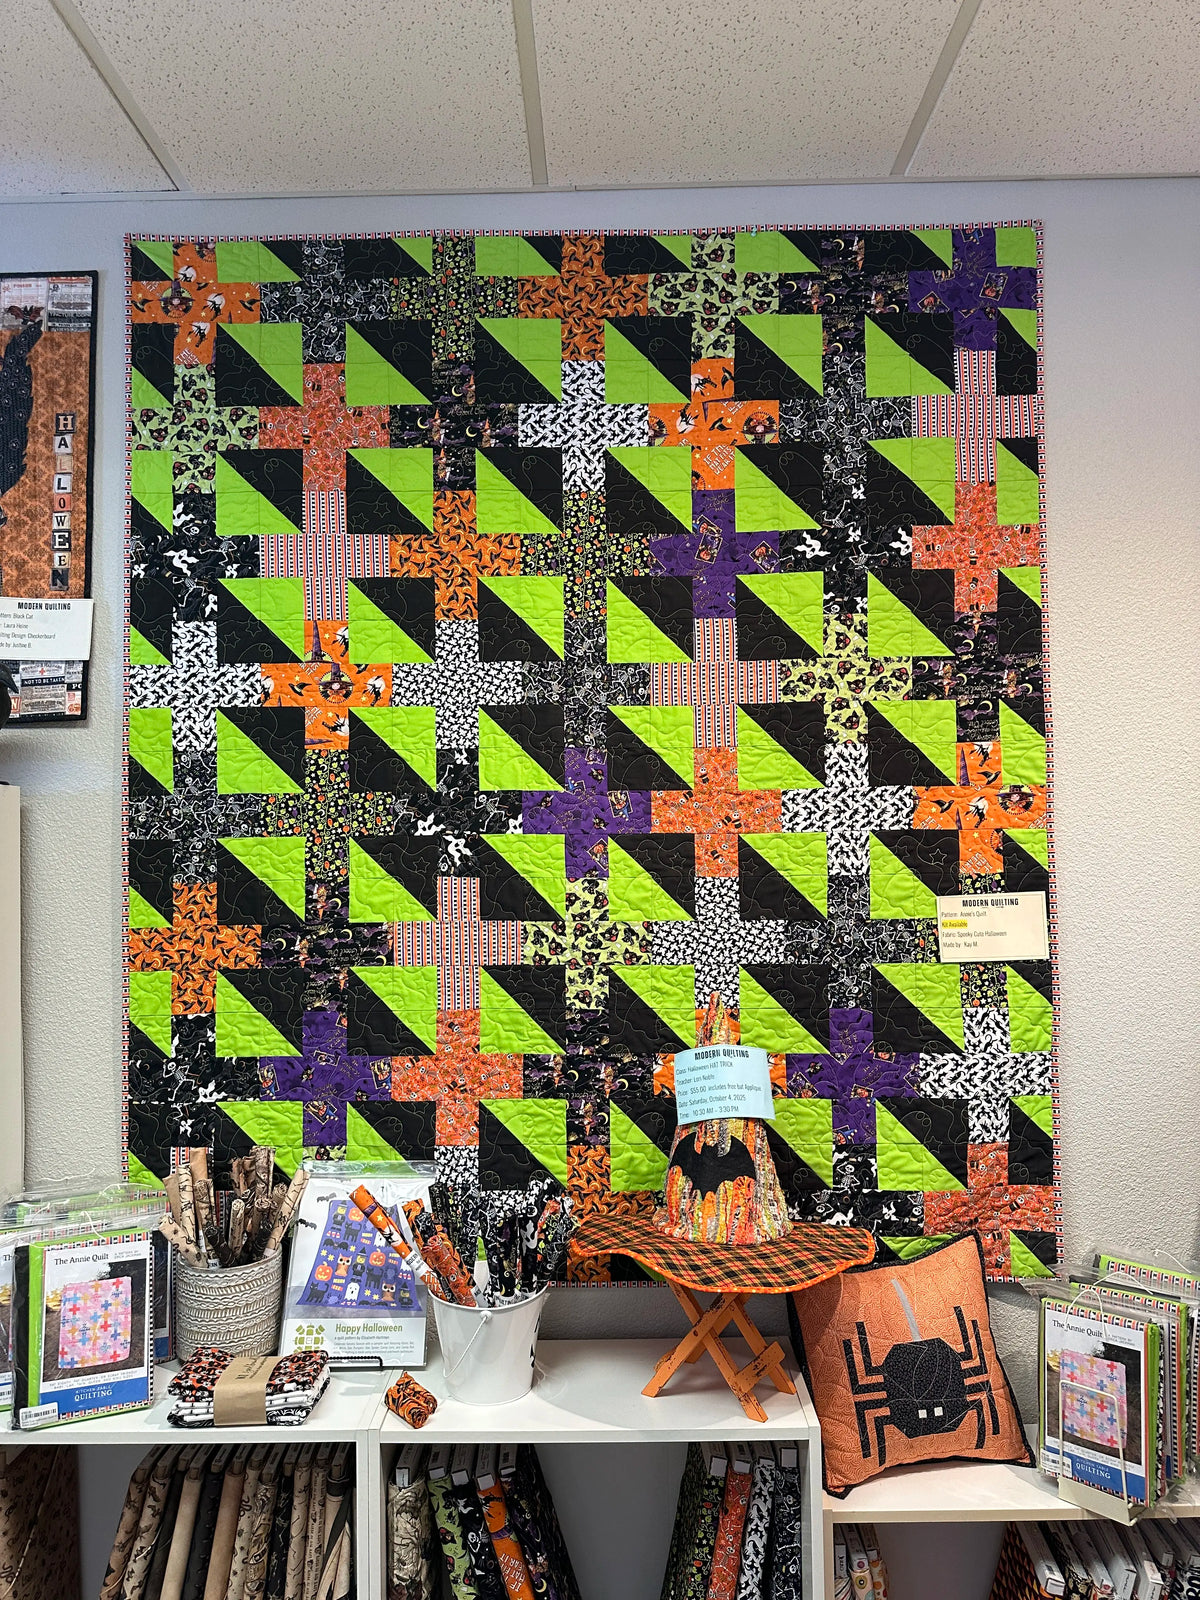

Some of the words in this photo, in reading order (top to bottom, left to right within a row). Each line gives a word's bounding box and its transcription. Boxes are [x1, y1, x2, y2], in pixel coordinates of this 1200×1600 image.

[18, 602, 42, 610] MODERN
[44, 602, 71, 610] QUILTING
[990, 898, 1018, 906] QUILTING
[694, 1051, 720, 1060] MODERN
[722, 1048, 750, 1058] QUILTING
[688, 1064, 710, 1072] Halloween
[70, 1255, 90, 1264] Annie
[92, 1252, 109, 1261] Quilt
[336, 1324, 361, 1335] Happy
[363, 1323, 402, 1332] Halloween
[1052, 1320, 1064, 1328] The
[1066, 1323, 1086, 1334] Annie
[1086, 1328, 1103, 1338] Quilt
[74, 1390, 112, 1402] QUILTING
[1076, 1462, 1111, 1479] QUILTING
